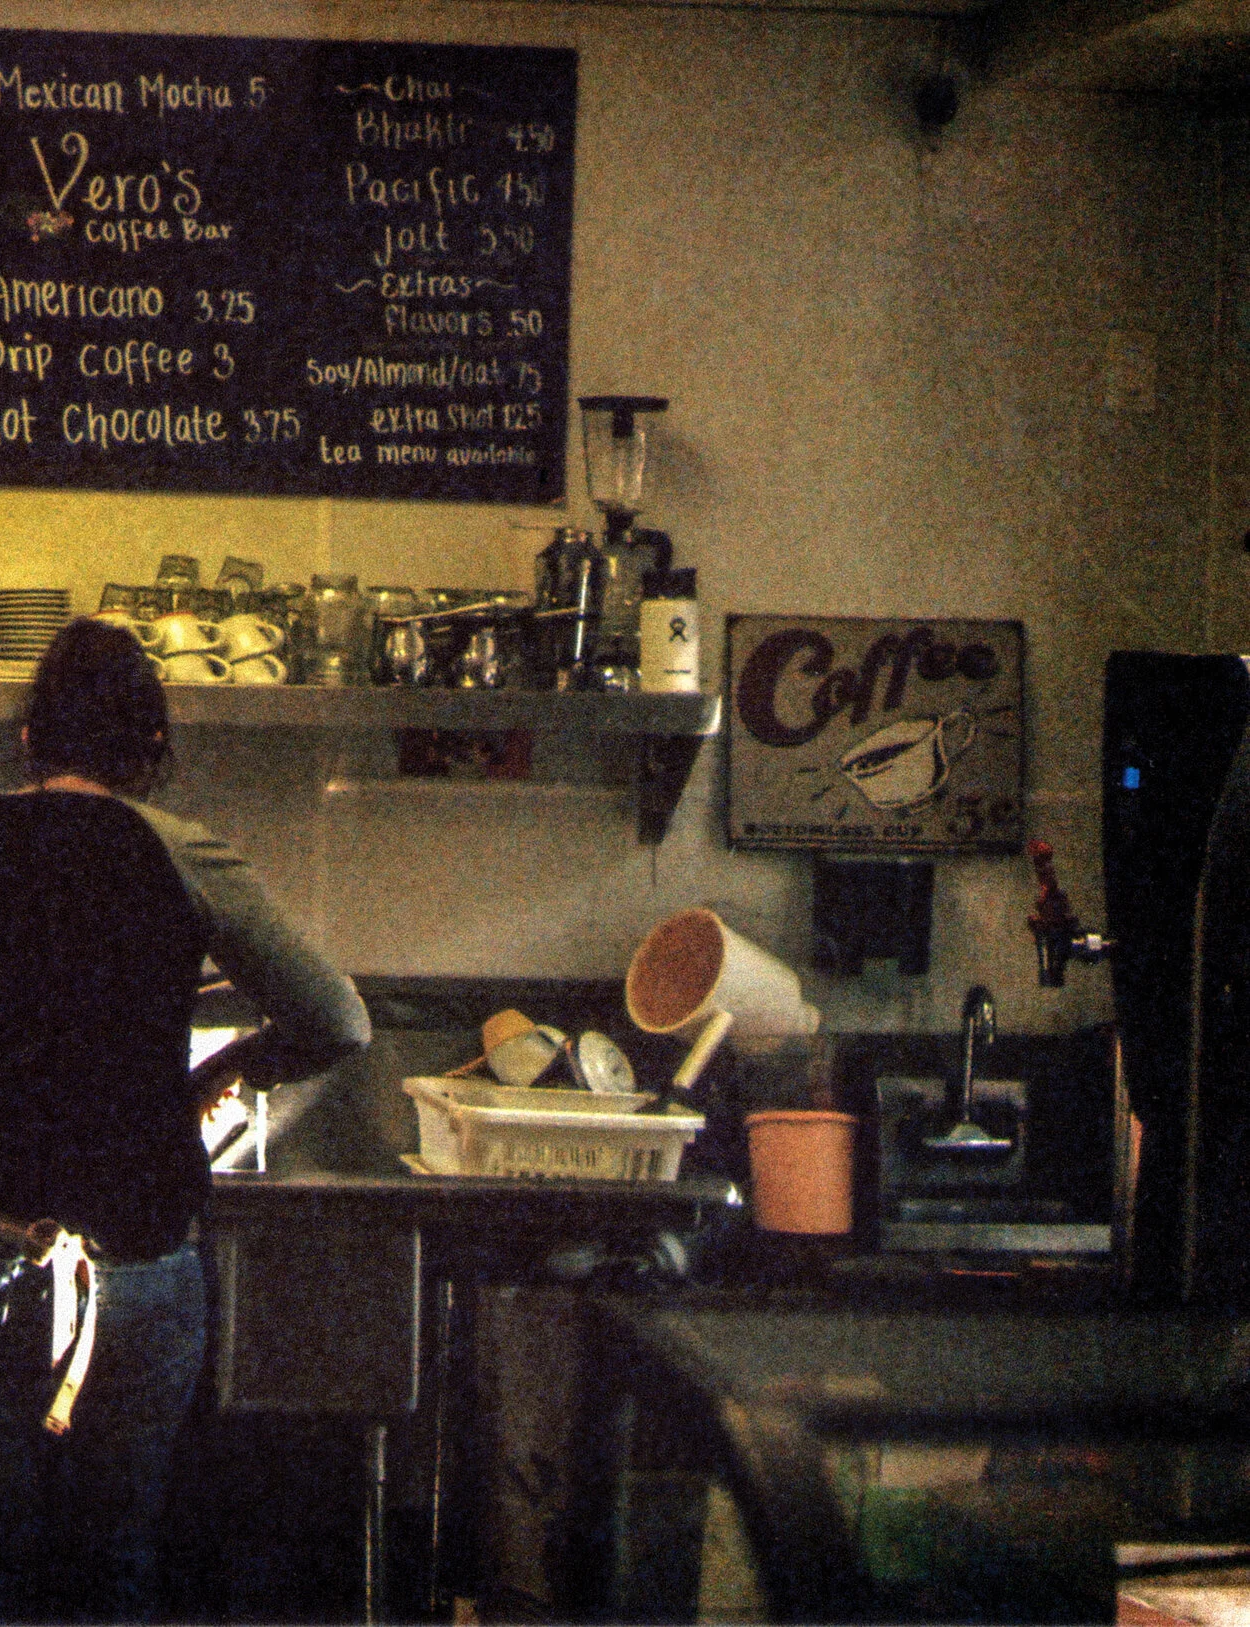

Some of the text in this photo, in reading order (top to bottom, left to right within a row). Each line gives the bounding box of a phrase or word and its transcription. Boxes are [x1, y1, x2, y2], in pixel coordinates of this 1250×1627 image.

[140, 72, 233, 118] Mocha
[249, 76, 268, 108] 5
[29, 131, 202, 216] Vero's
[347, 162, 480, 218] Pacific
[182, 217, 234, 242] Bar
[212, 343, 236, 381] 3
[62, 402, 228, 450] Chocolate
[319, 435, 362, 466] tea
